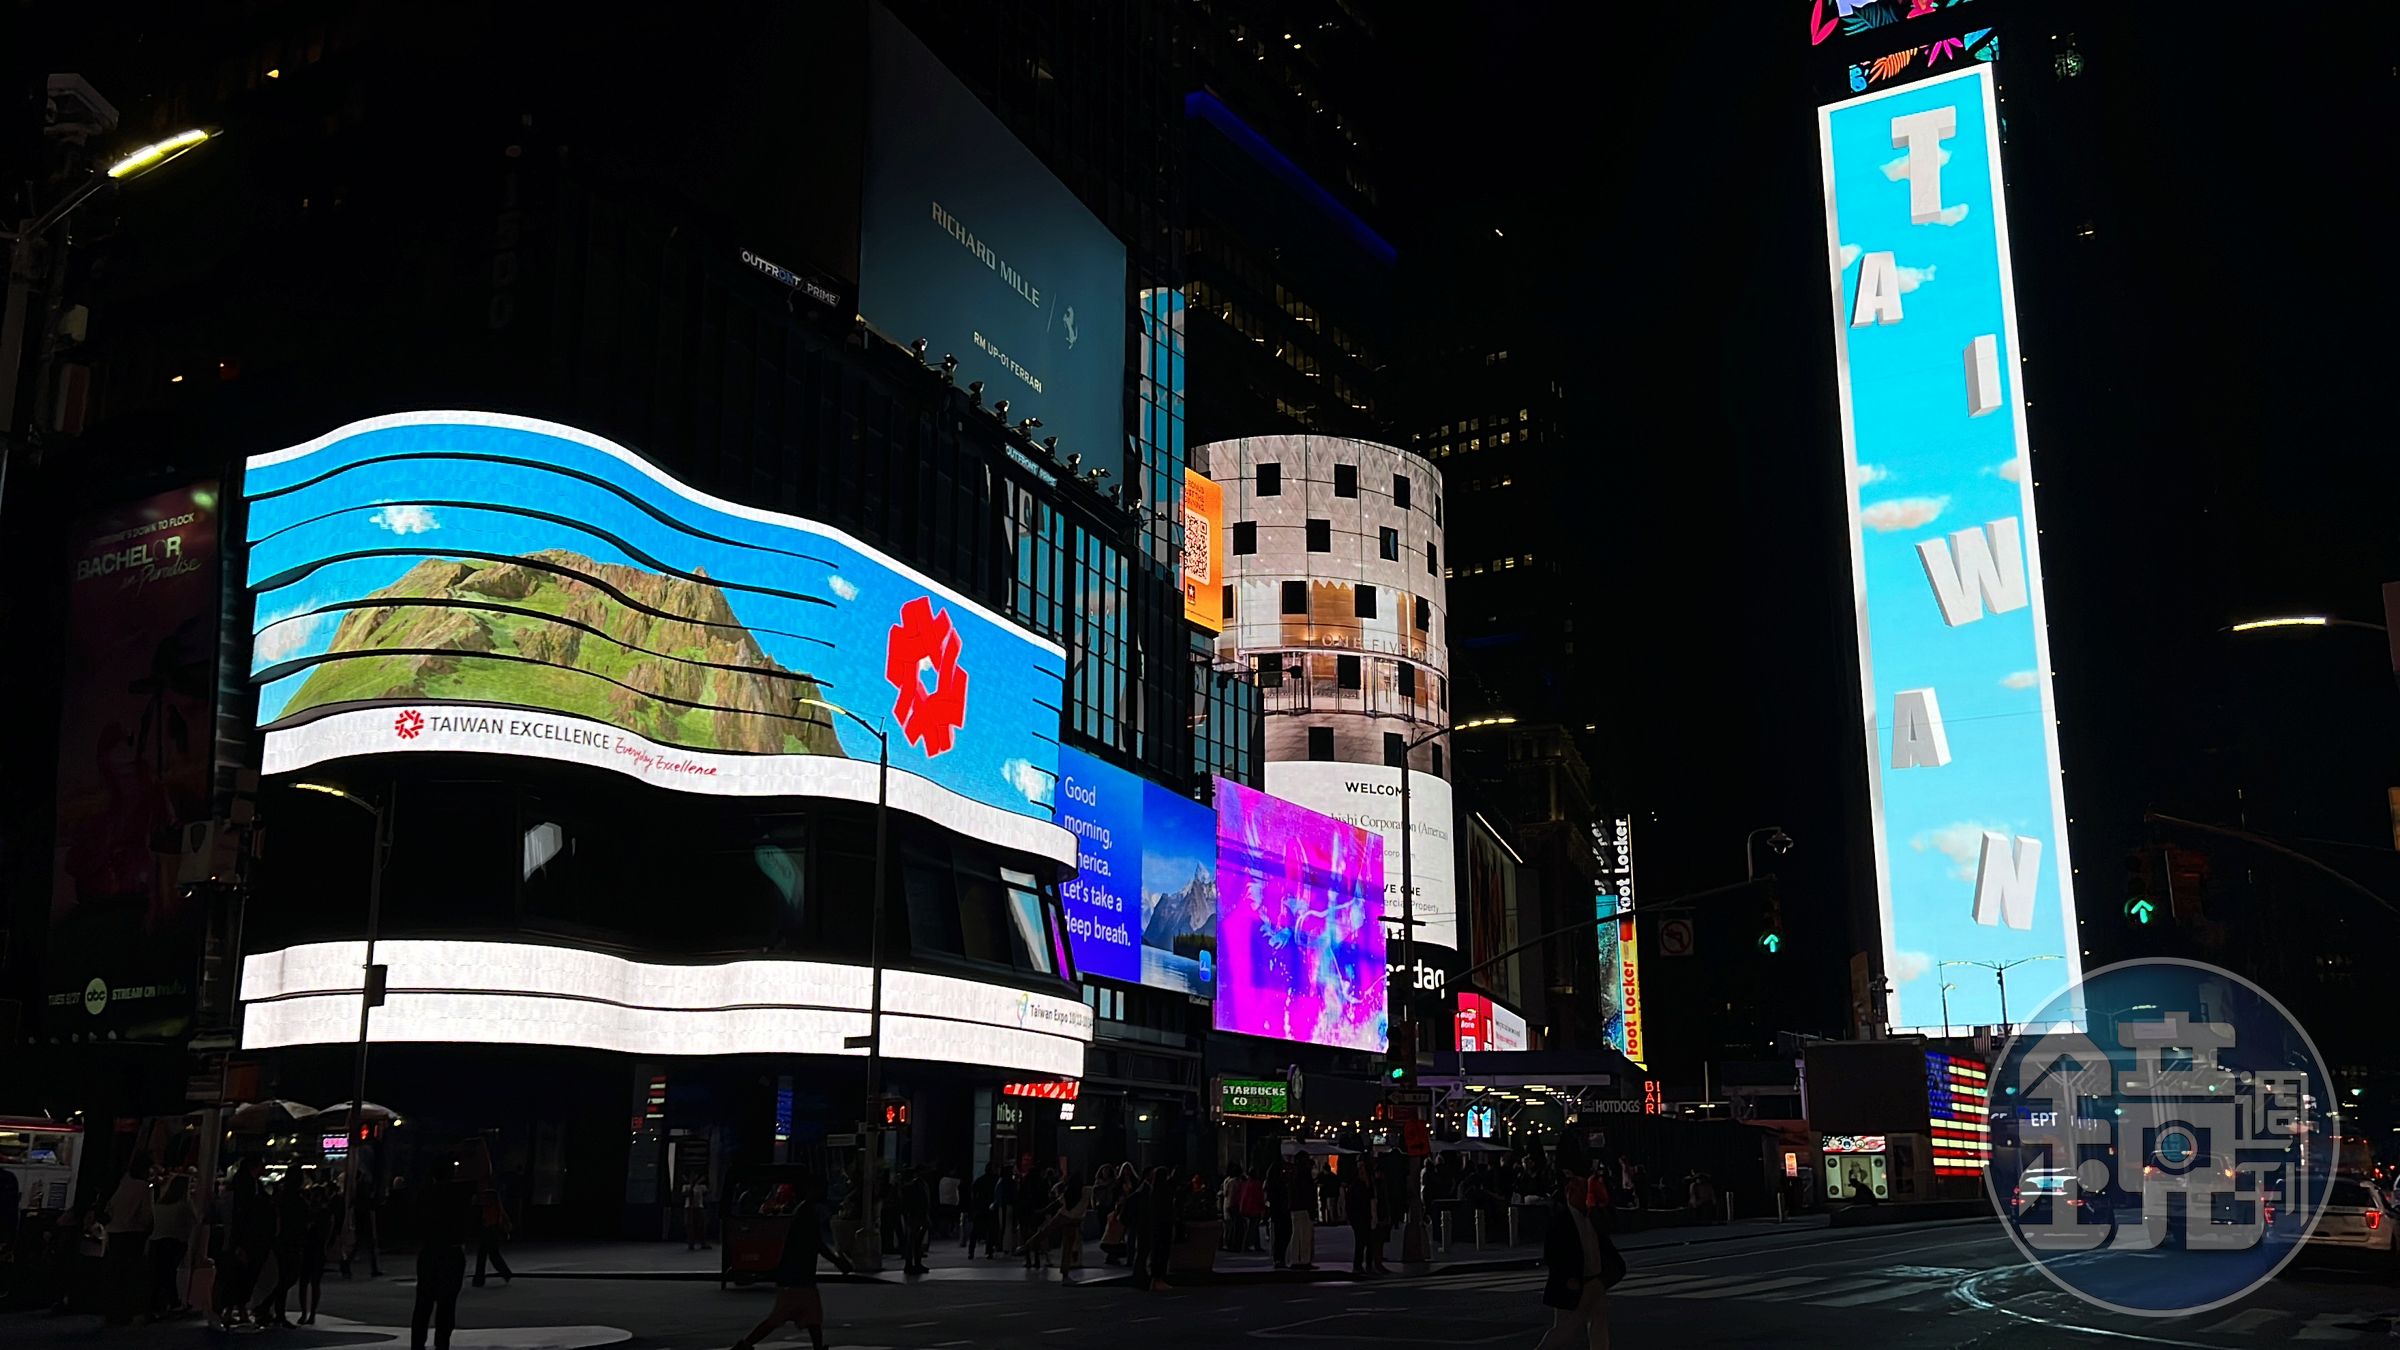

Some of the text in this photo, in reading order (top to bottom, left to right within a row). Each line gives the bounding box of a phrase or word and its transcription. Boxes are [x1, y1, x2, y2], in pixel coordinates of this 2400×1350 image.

[931, 200, 1041, 308] RICHARD MILLE
[741, 250, 837, 305] OUTFRONT PRIME
[973, 331, 987, 351] RM
[1010, 361, 1042, 394] FERRARI
[169, 512, 196, 527] FLOCK
[77, 536, 181, 582] BACHELOR
[430, 716, 610, 749] TAIWAN EXCELLENCE
[614, 737, 718, 776] Everyday Excellence
[1065, 775, 1096, 807] Good
[1064, 813, 1113, 849] morning,
[1612, 819, 1630, 874] Locker
[1091, 885, 1114, 910] take
[1116, 896, 1123, 912] a
[1094, 915, 1131, 946] breath.
[86, 990, 106, 1002] abc
[1622, 961, 1638, 1057] Foot Locker
[1030, 1004, 1053, 1020] Taiwan
[1053, 1009, 1069, 1025] Expo
[1222, 1086, 1286, 1096] STARBUCKS
[1595, 1100, 1641, 1113] HOTDOGS
[2030, 1112, 2058, 1127] EPT
